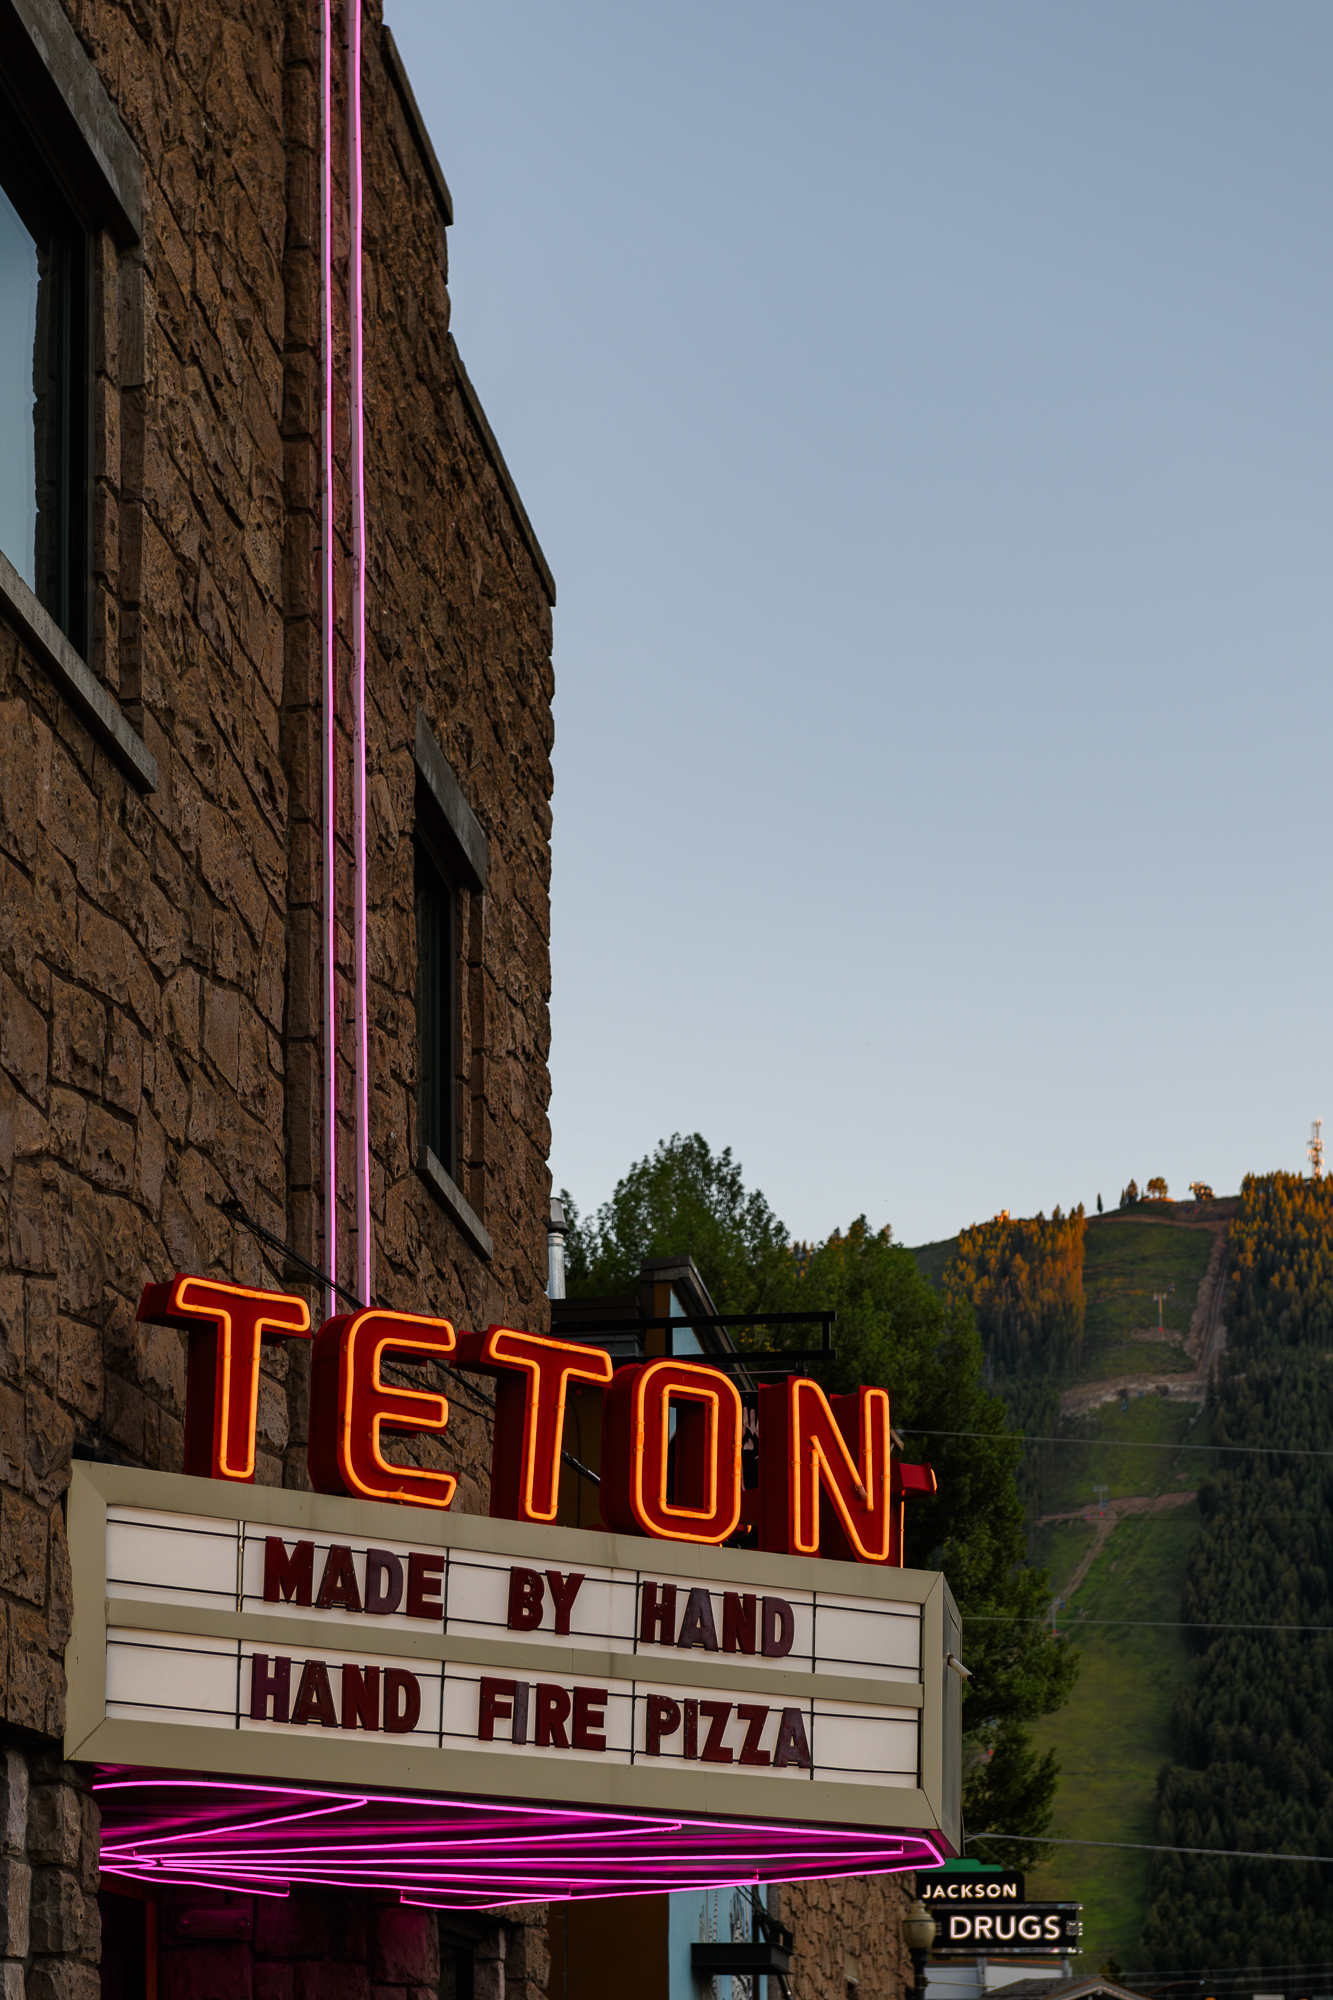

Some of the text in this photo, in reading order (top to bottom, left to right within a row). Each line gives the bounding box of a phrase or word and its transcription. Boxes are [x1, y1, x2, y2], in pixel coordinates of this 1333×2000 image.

[173, 1273, 892, 1563] TETON
[263, 1536, 795, 1658] MADE BY HAND
[250, 1653, 813, 1769] HAND FIRE PIZZA
[922, 1883, 1017, 1898] JACKSON
[949, 1915, 1061, 1940] DRUGS
